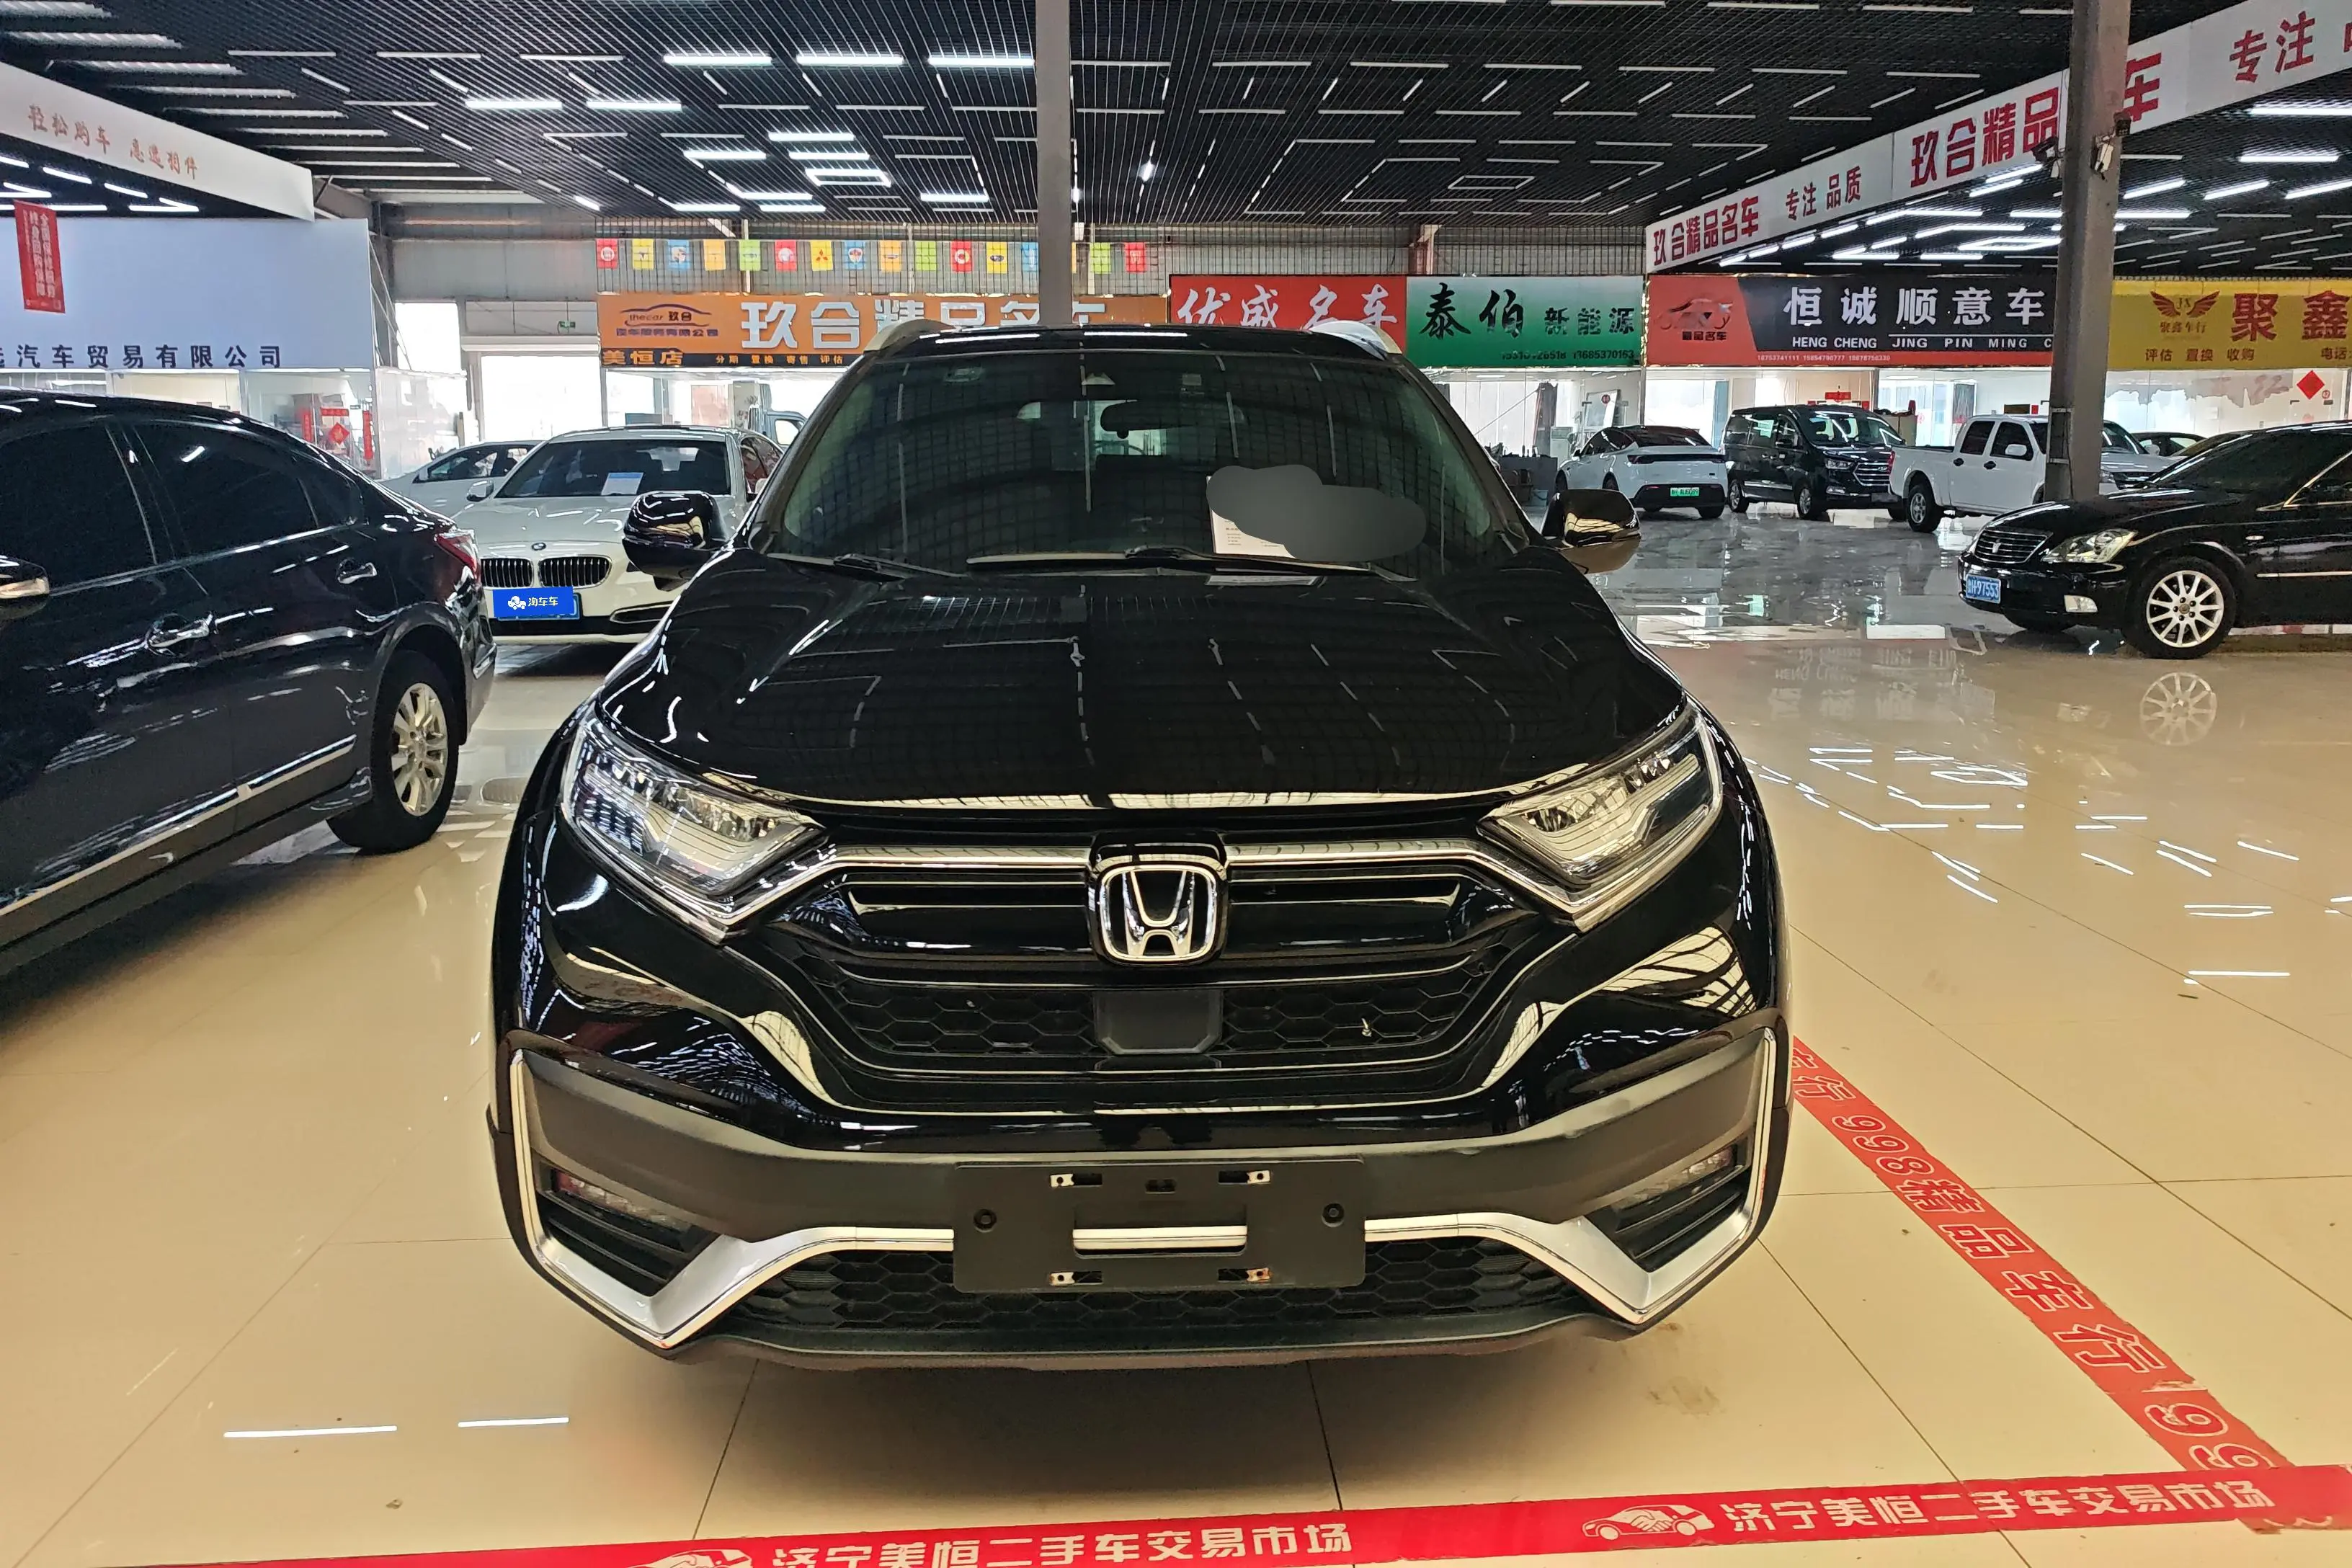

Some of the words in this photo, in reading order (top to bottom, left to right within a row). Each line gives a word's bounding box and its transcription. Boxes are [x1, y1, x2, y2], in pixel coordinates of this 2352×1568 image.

[2230, 11, 2352, 83] 专注
[28, 104, 110, 154] 轻松购车
[1910, 52, 2162, 188] 玖合精品车
[1785, 165, 1861, 221] 专注品质
[1653, 196, 1759, 266] 玖合精品名车
[1420, 282, 1524, 339] 泰伯
[1544, 306, 1635, 336] 新能源
[1783, 286, 2045, 326] 恒诚顺意车
[2230, 290, 2351, 342] 聚鑫
[602, 349, 684, 366] 美恒店
[716, 355, 739, 365] 分期
[751, 355, 775, 365] 置换
[786, 355, 808, 365] 寄售
[820, 355, 844, 365] 评估
[1792, 336, 1827, 348] HENG
[1833, 337, 1878, 349] CHENG
[1892, 337, 1928, 349] JING
[1944, 337, 1974, 348] PIN
[1988, 337, 2028, 349] MING
[2144, 348, 2173, 362] 评估
[2185, 348, 2214, 362] 置换
[2227, 347, 2255, 362] 收购
[1719, 1479, 2276, 1531] 济宁美恒二手车交易市场
[772, 1523, 1355, 1568] 济宁美恒二手车交易市场
